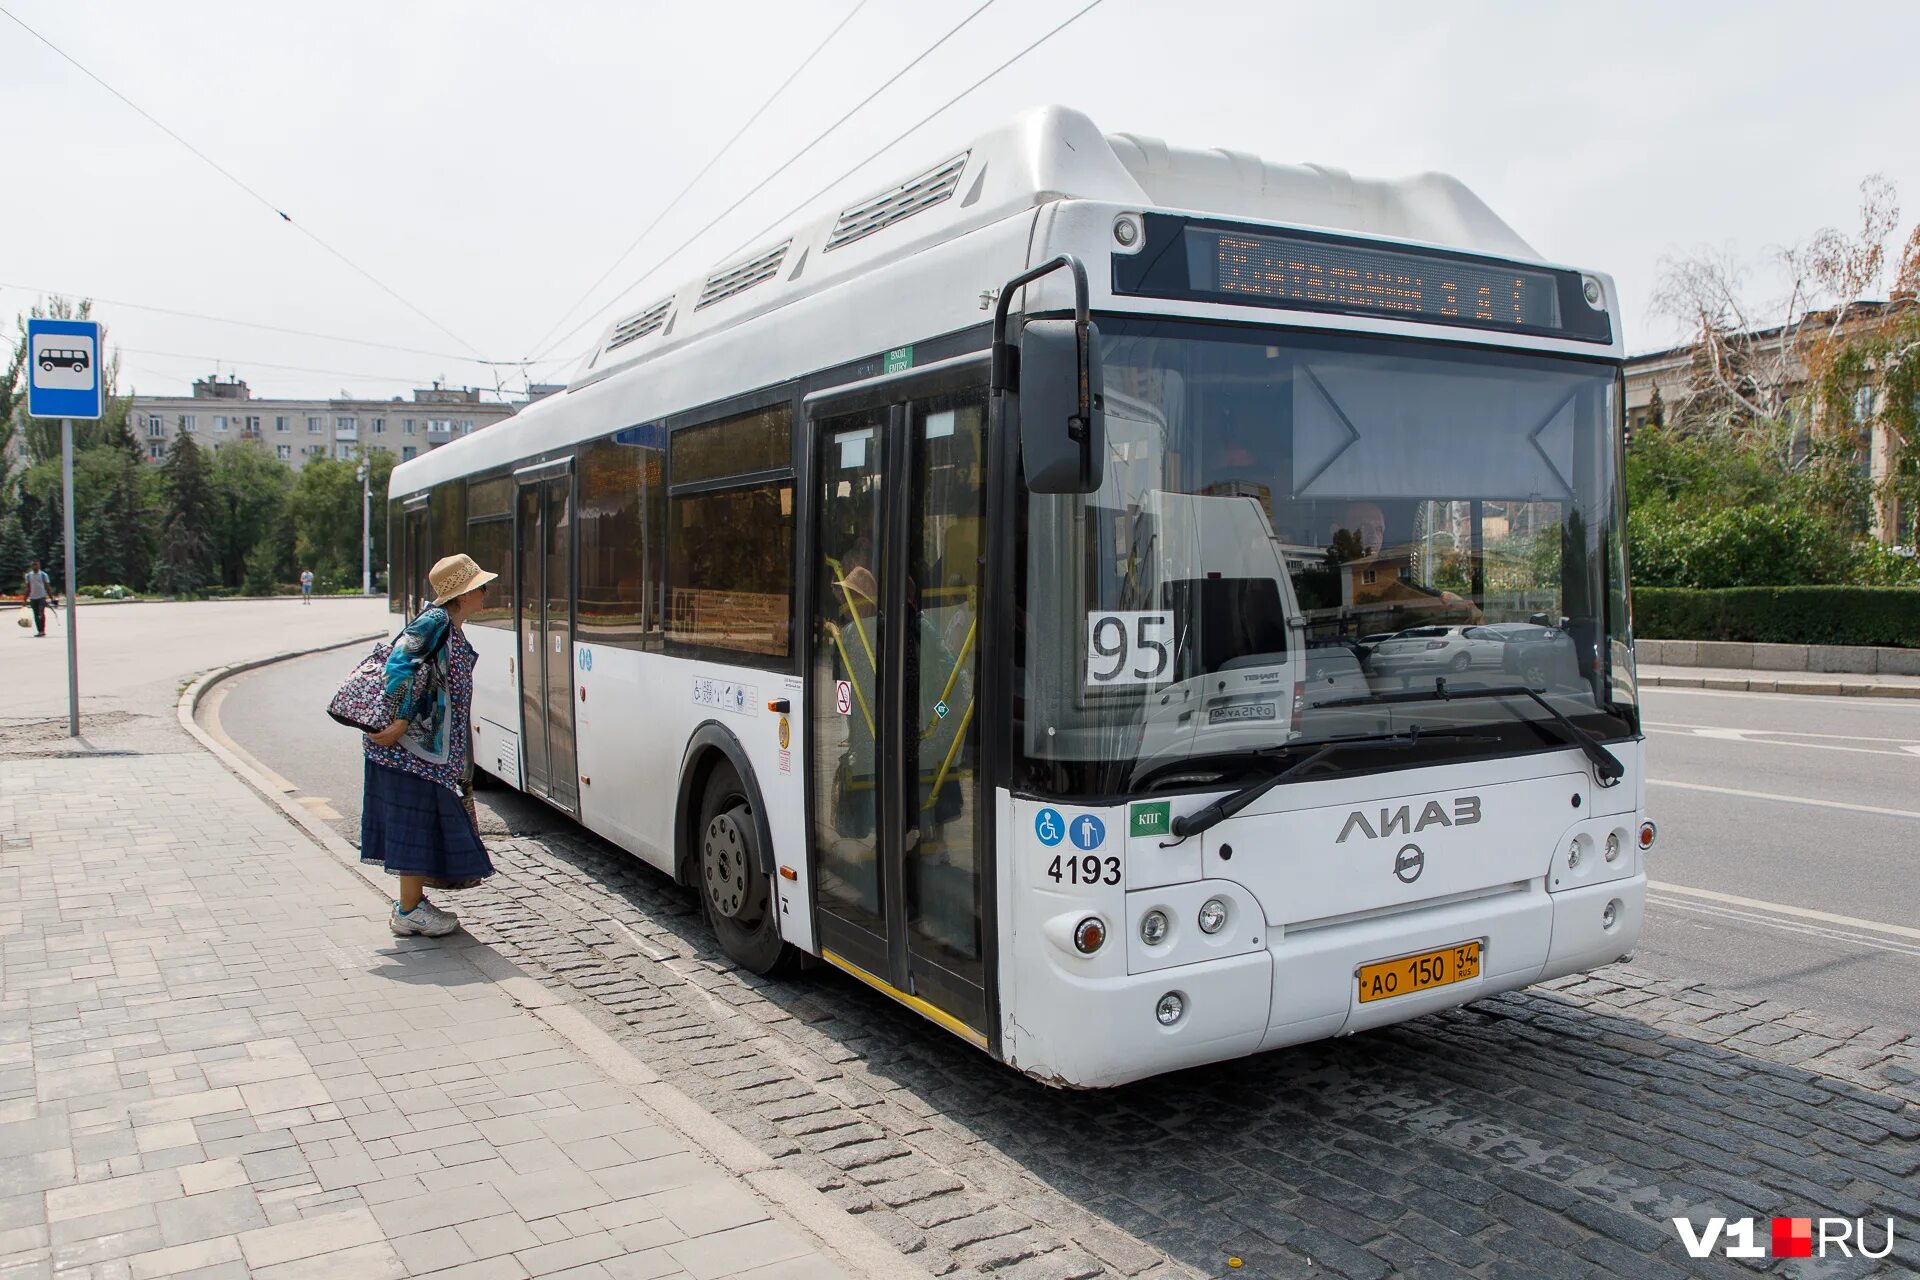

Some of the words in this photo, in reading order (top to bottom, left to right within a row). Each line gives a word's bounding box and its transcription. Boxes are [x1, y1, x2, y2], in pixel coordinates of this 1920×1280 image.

[889, 361, 907, 373] ENTRY
[1092, 616, 1168, 682] 95
[1138, 812, 1162, 825] КПГ
[1336, 796, 1482, 843] ЛИАЗ
[1047, 855, 1121, 886] 4193
[1408, 956, 1444, 987] 150
[1456, 947, 1474, 970] 34
[1458, 967, 1472, 978] RUS
